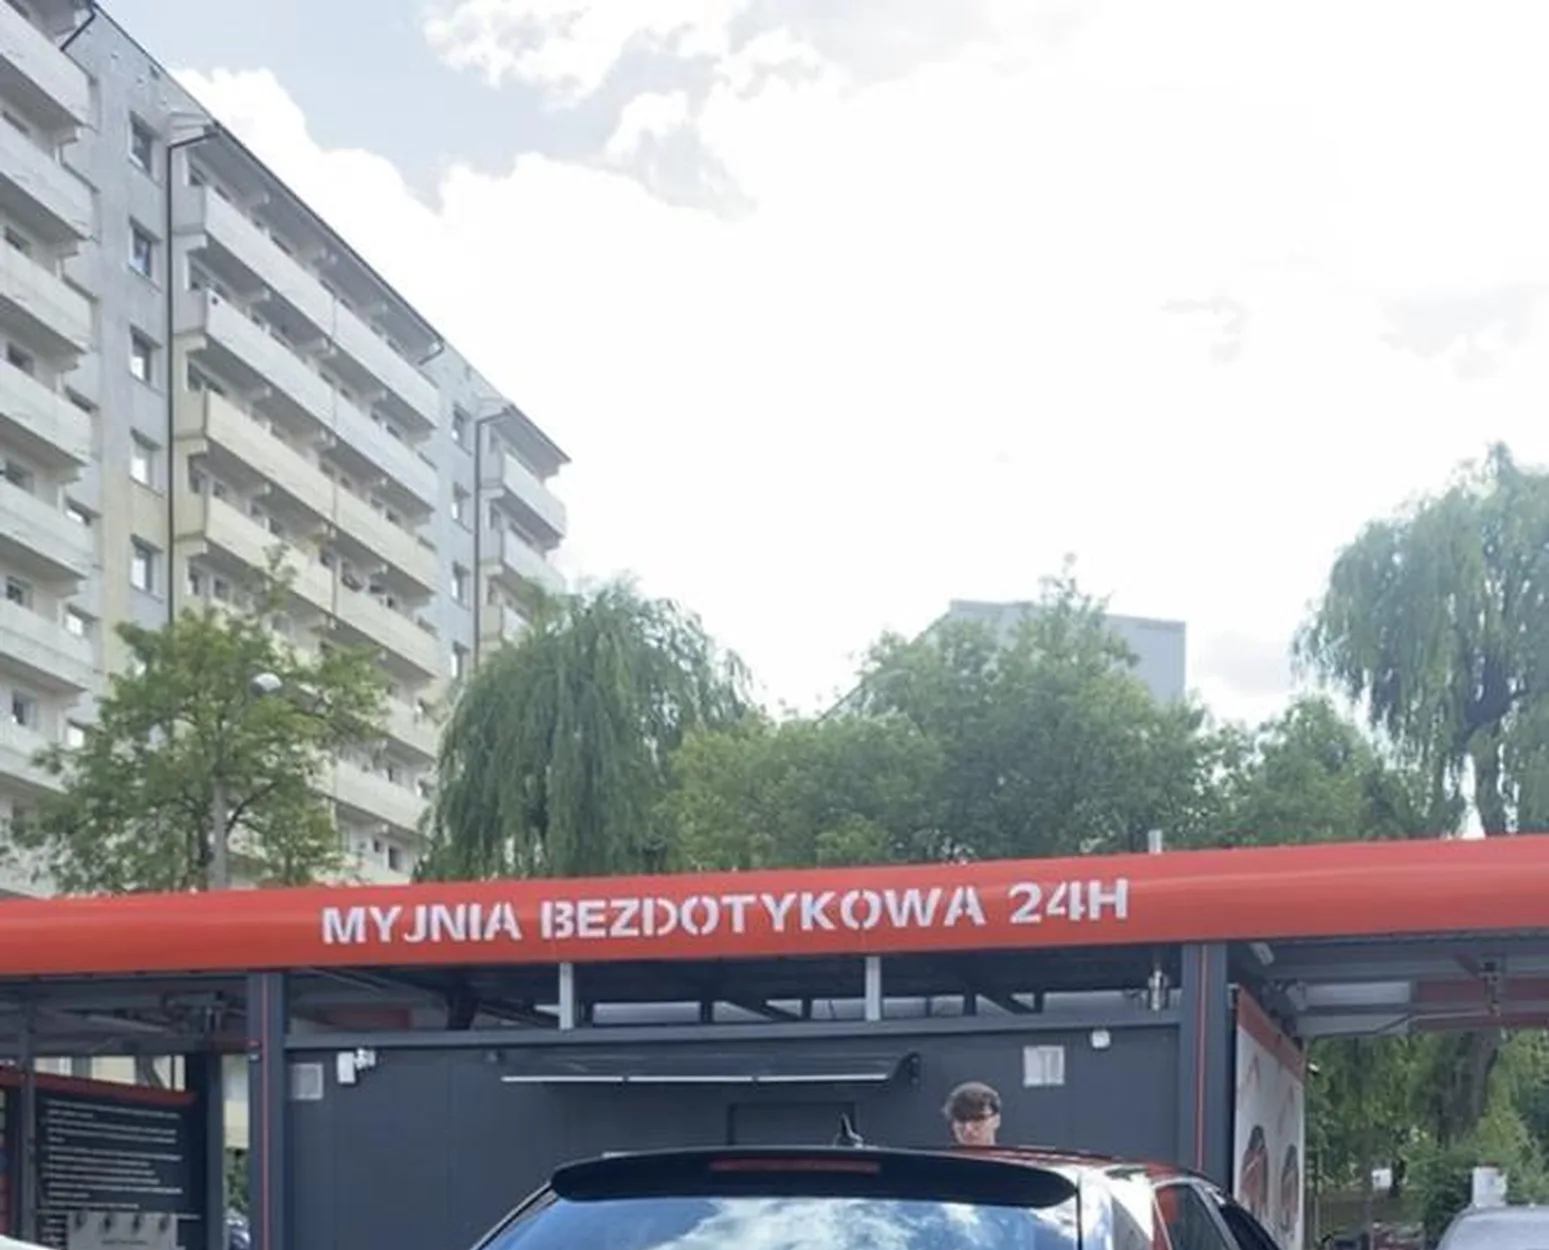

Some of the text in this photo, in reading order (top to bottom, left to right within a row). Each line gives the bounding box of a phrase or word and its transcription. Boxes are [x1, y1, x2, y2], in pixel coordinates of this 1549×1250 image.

[322, 878, 1129, 944] MYJNIA BEZDOTYKOWA 24H
